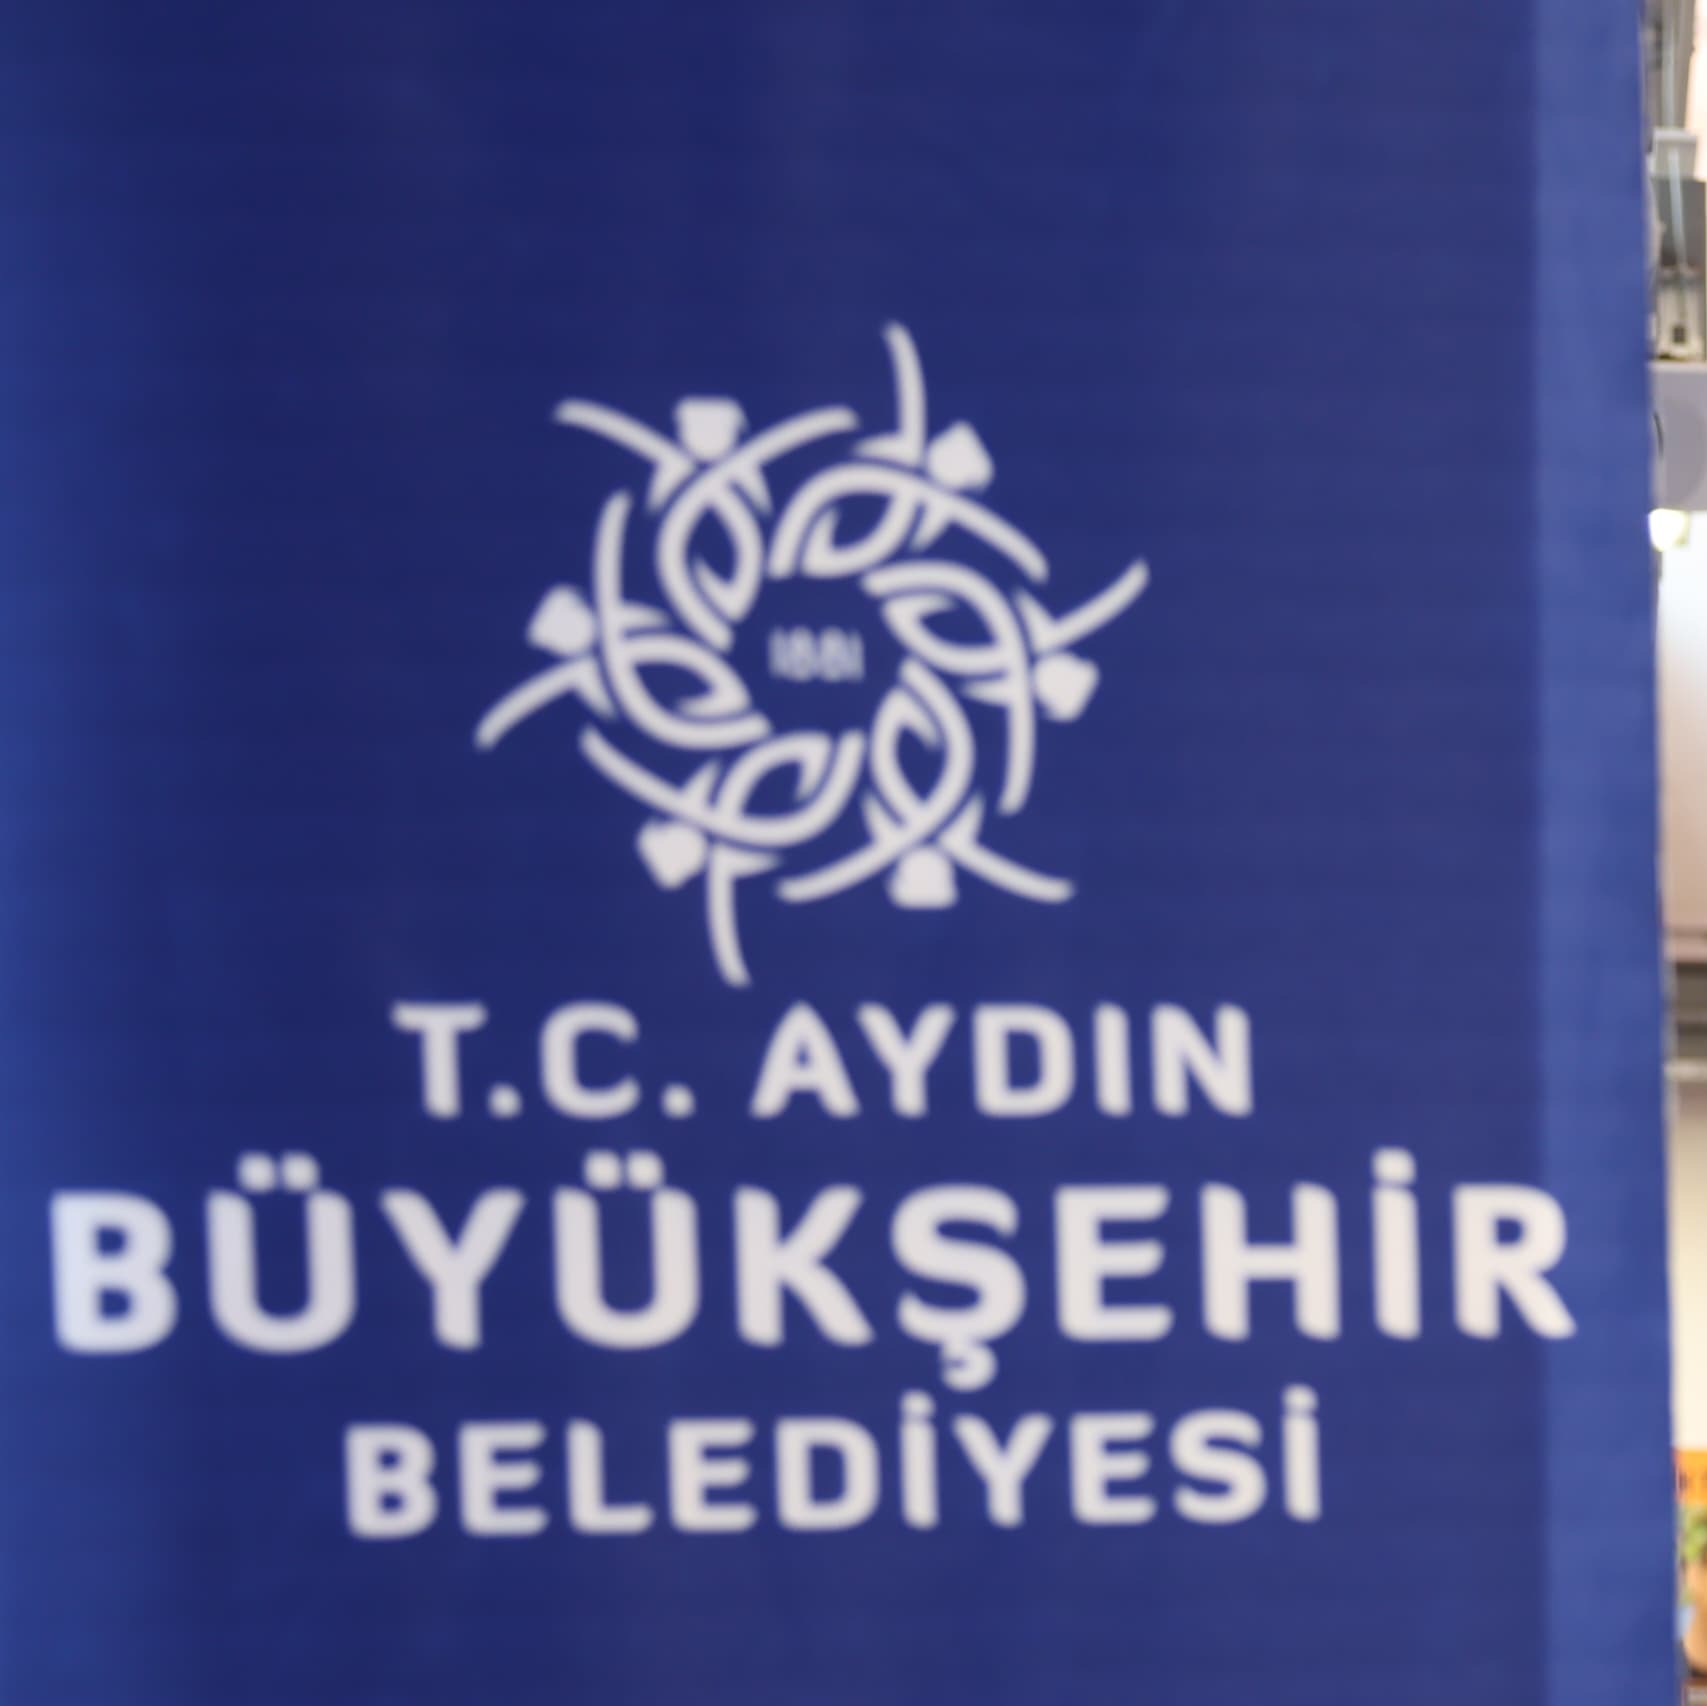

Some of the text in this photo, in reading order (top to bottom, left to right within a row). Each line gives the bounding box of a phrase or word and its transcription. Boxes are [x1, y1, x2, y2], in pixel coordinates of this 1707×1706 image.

[392, 1000, 1255, 1120] T.C. AYDIN
[50, 1149, 1577, 1392] BÜYÜKŞEHİR
[343, 1384, 1324, 1538] BELEDİYESİ
